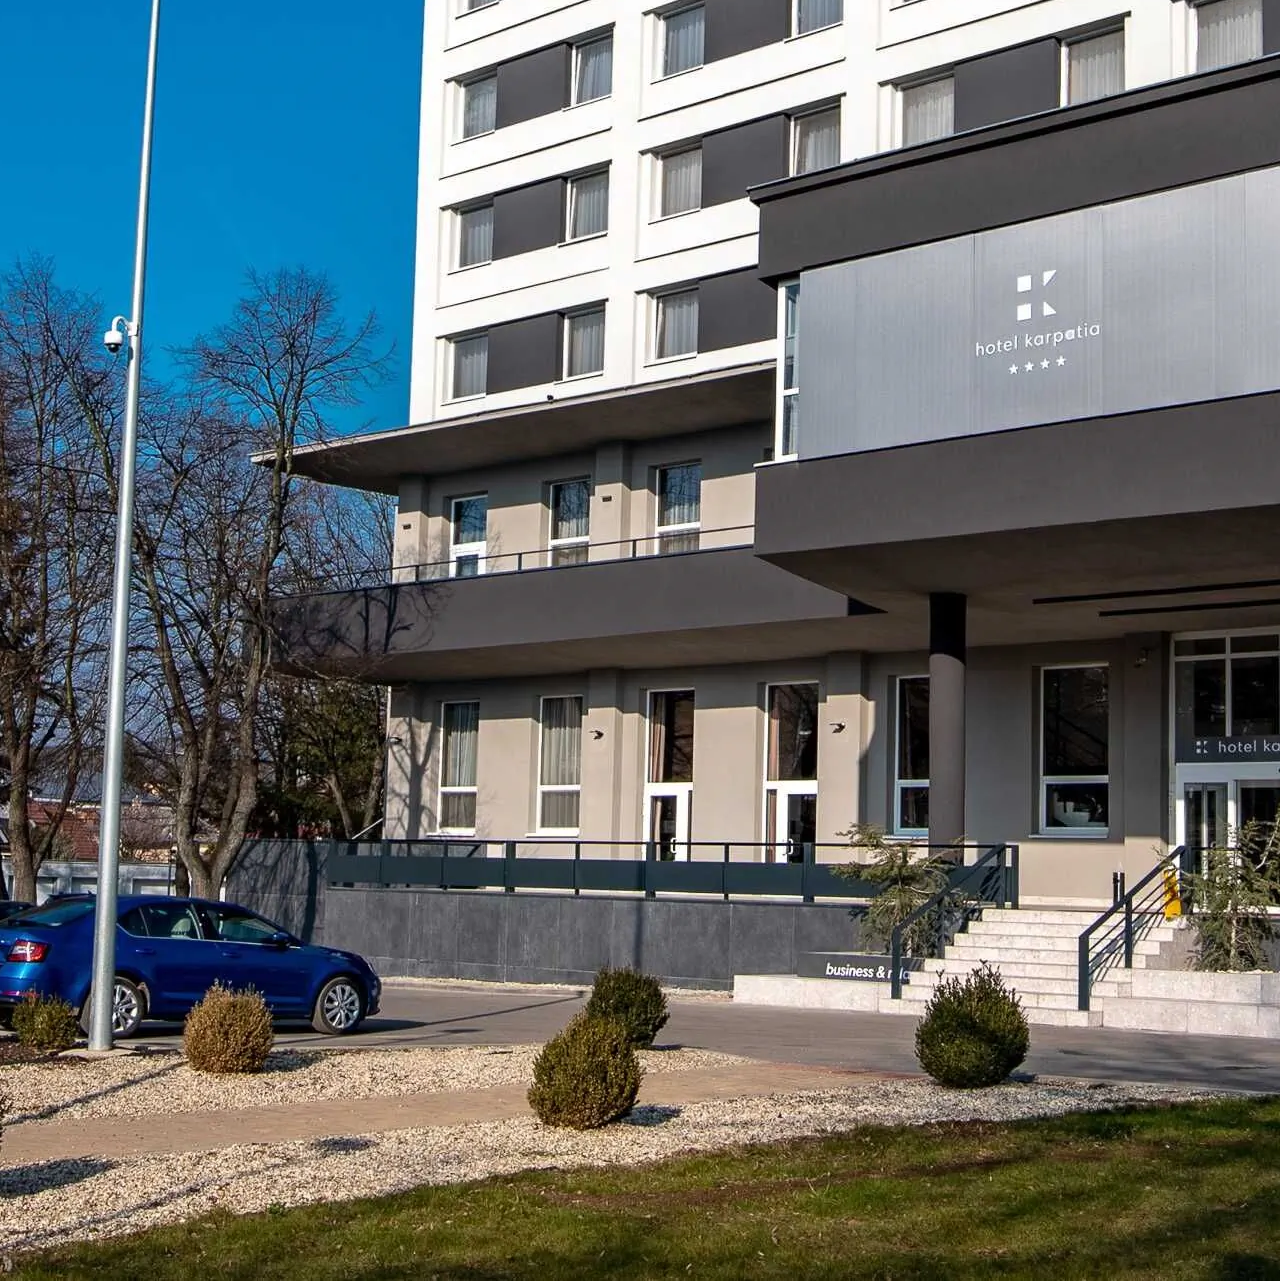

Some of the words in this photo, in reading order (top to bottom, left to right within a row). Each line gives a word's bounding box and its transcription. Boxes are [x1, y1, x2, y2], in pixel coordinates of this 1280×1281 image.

[975, 335, 1019, 356] hotel
[1025, 323, 1100, 347] karpatia
[1218, 739, 1257, 754] hotel
[825, 962, 874, 978] business
[876, 965, 886, 979] &
